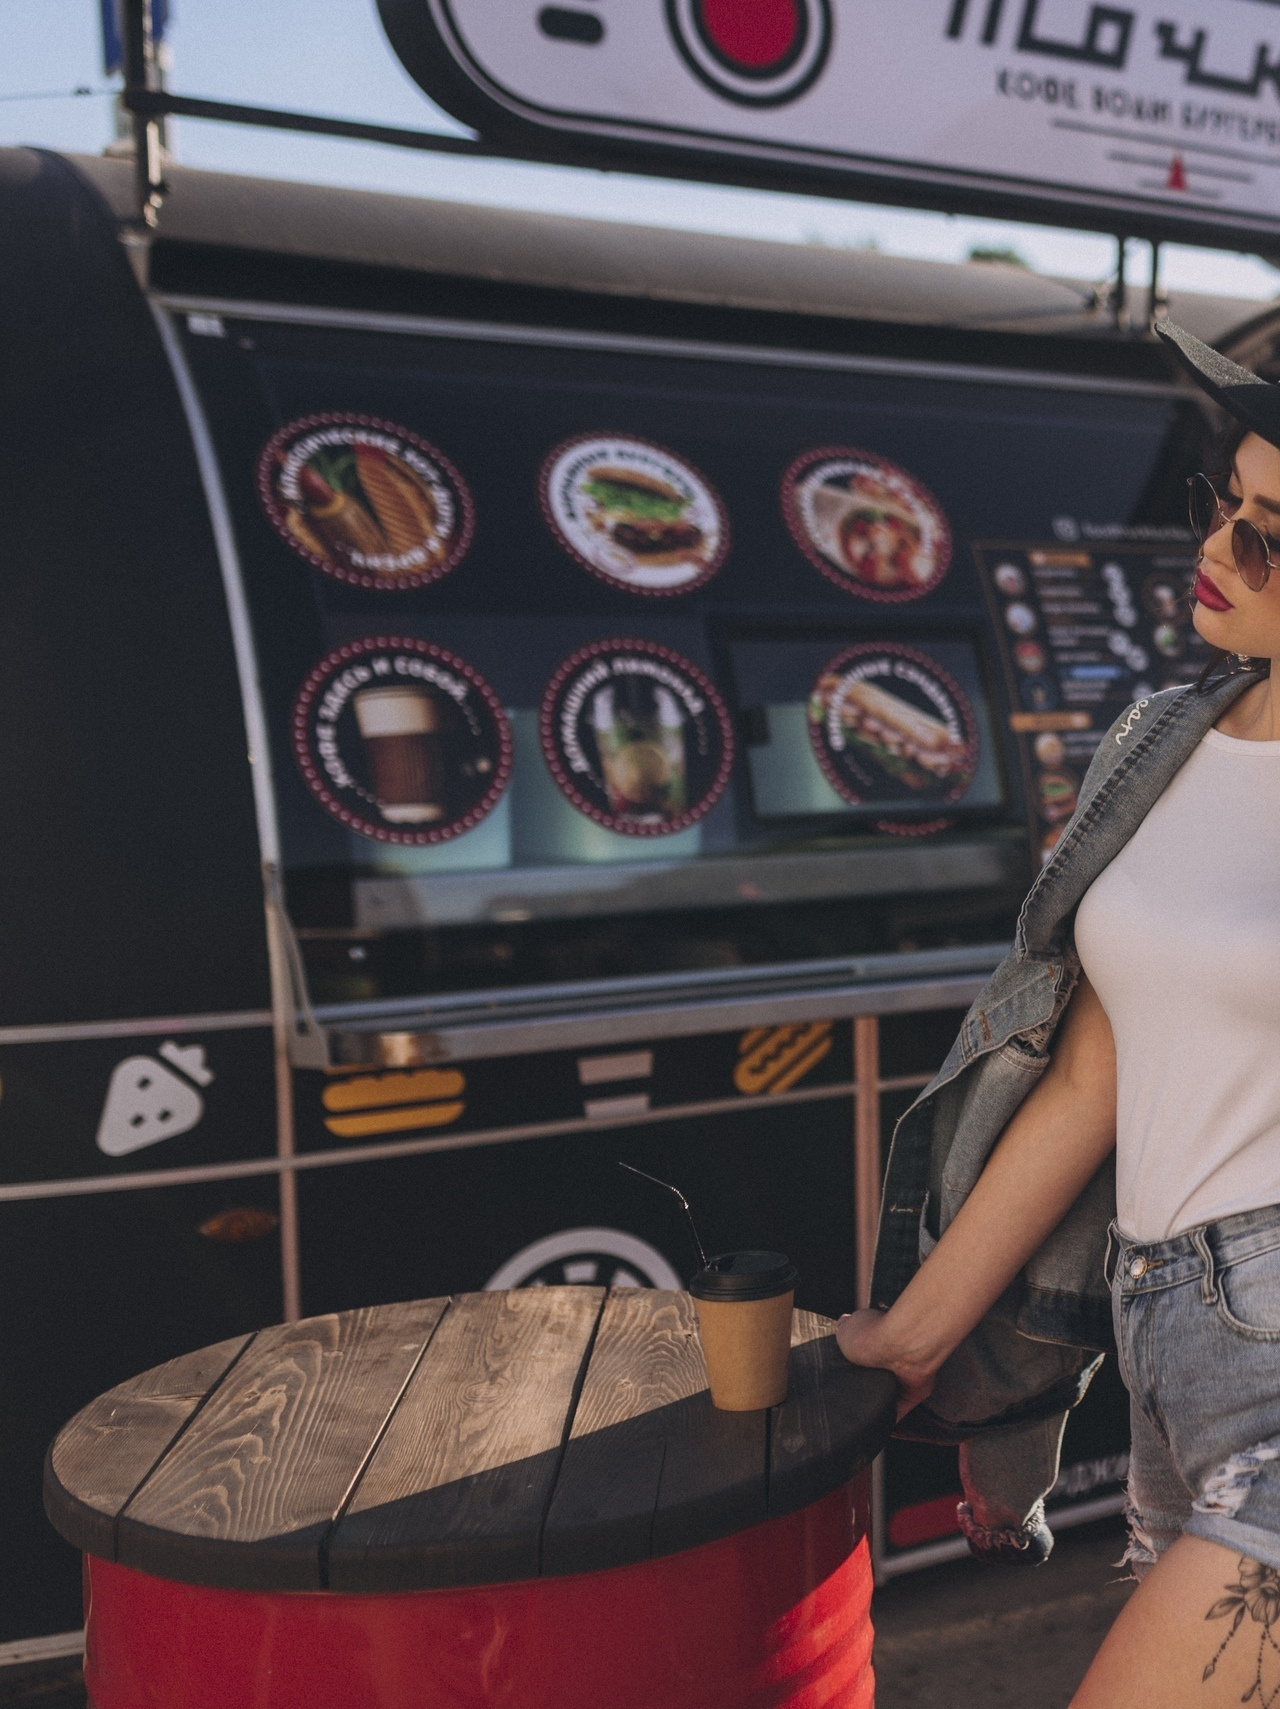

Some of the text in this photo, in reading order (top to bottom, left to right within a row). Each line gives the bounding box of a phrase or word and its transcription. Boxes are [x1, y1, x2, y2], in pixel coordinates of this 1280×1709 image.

[997, 68, 1078, 108] КОФЕ
[318, 665, 373, 721] ЗДЕСЬ
[315, 724, 353, 788] КОФЕ
